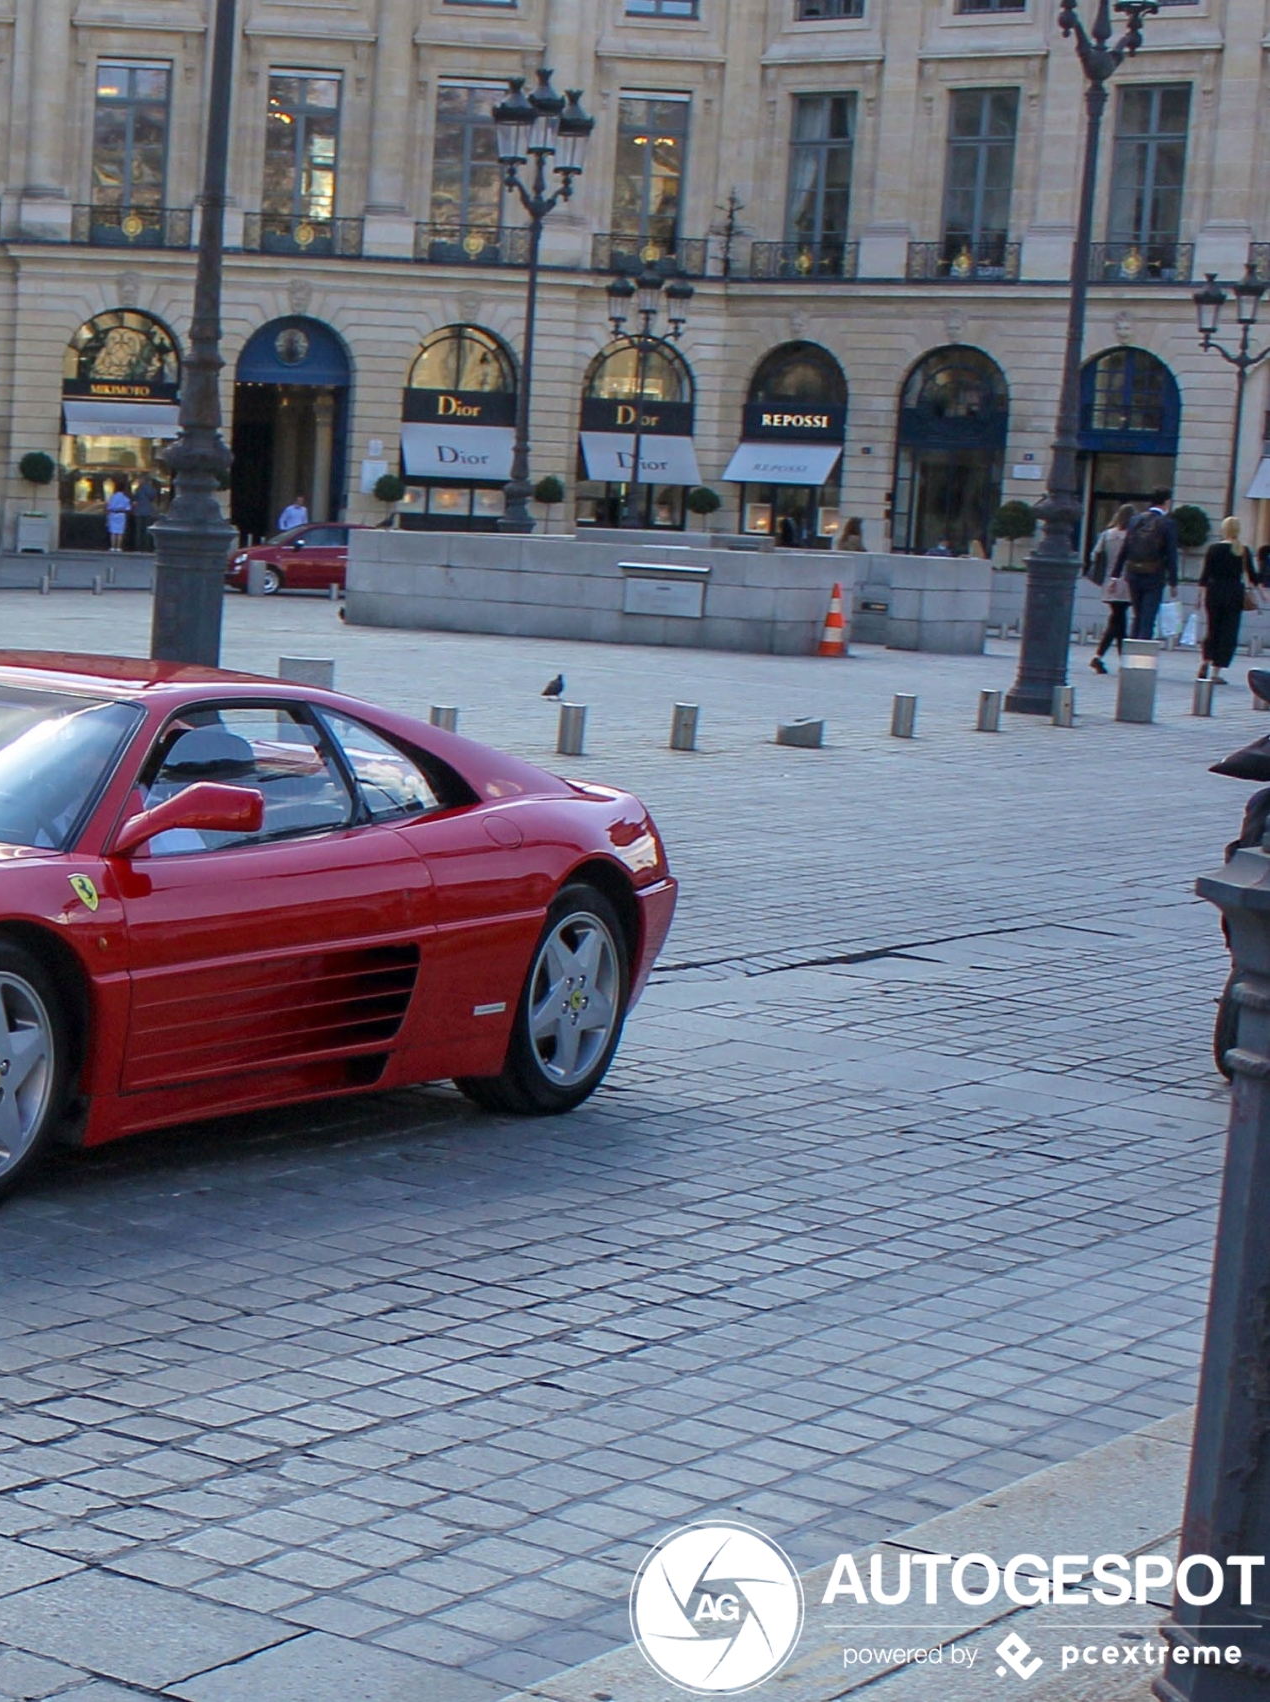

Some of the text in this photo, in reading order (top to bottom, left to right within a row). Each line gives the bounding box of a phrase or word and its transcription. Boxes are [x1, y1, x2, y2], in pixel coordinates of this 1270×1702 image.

[437, 395, 482, 418] Dior
[616, 404, 660, 427] Dor
[761, 413, 830, 429] REPOSSI
[436, 445, 490, 466] Dior
